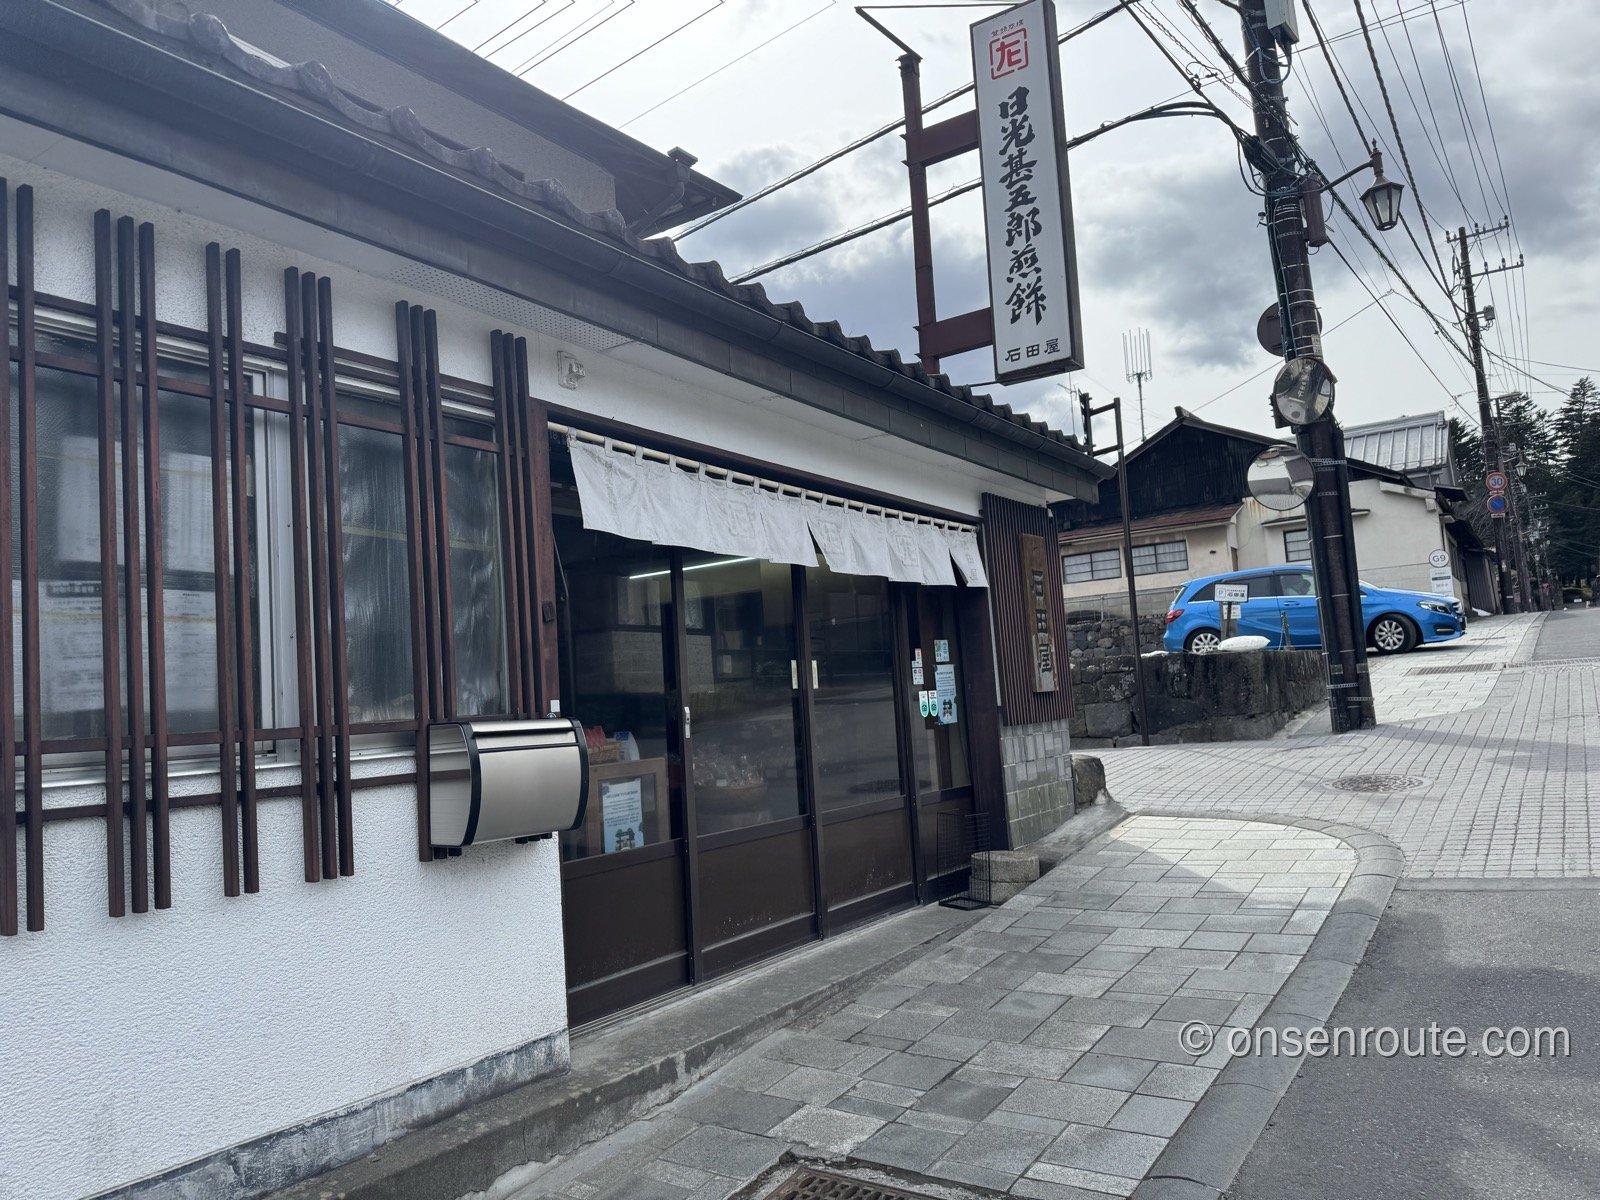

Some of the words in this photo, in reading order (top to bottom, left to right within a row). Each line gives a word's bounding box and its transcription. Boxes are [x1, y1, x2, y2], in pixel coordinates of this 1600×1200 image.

[998, 86, 1047, 326] 日光甚五郎煎餅
[1004, 338, 1061, 363] 石田屋
[1491, 477, 1503, 486] 30
[1432, 554, 1446, 563] G9
